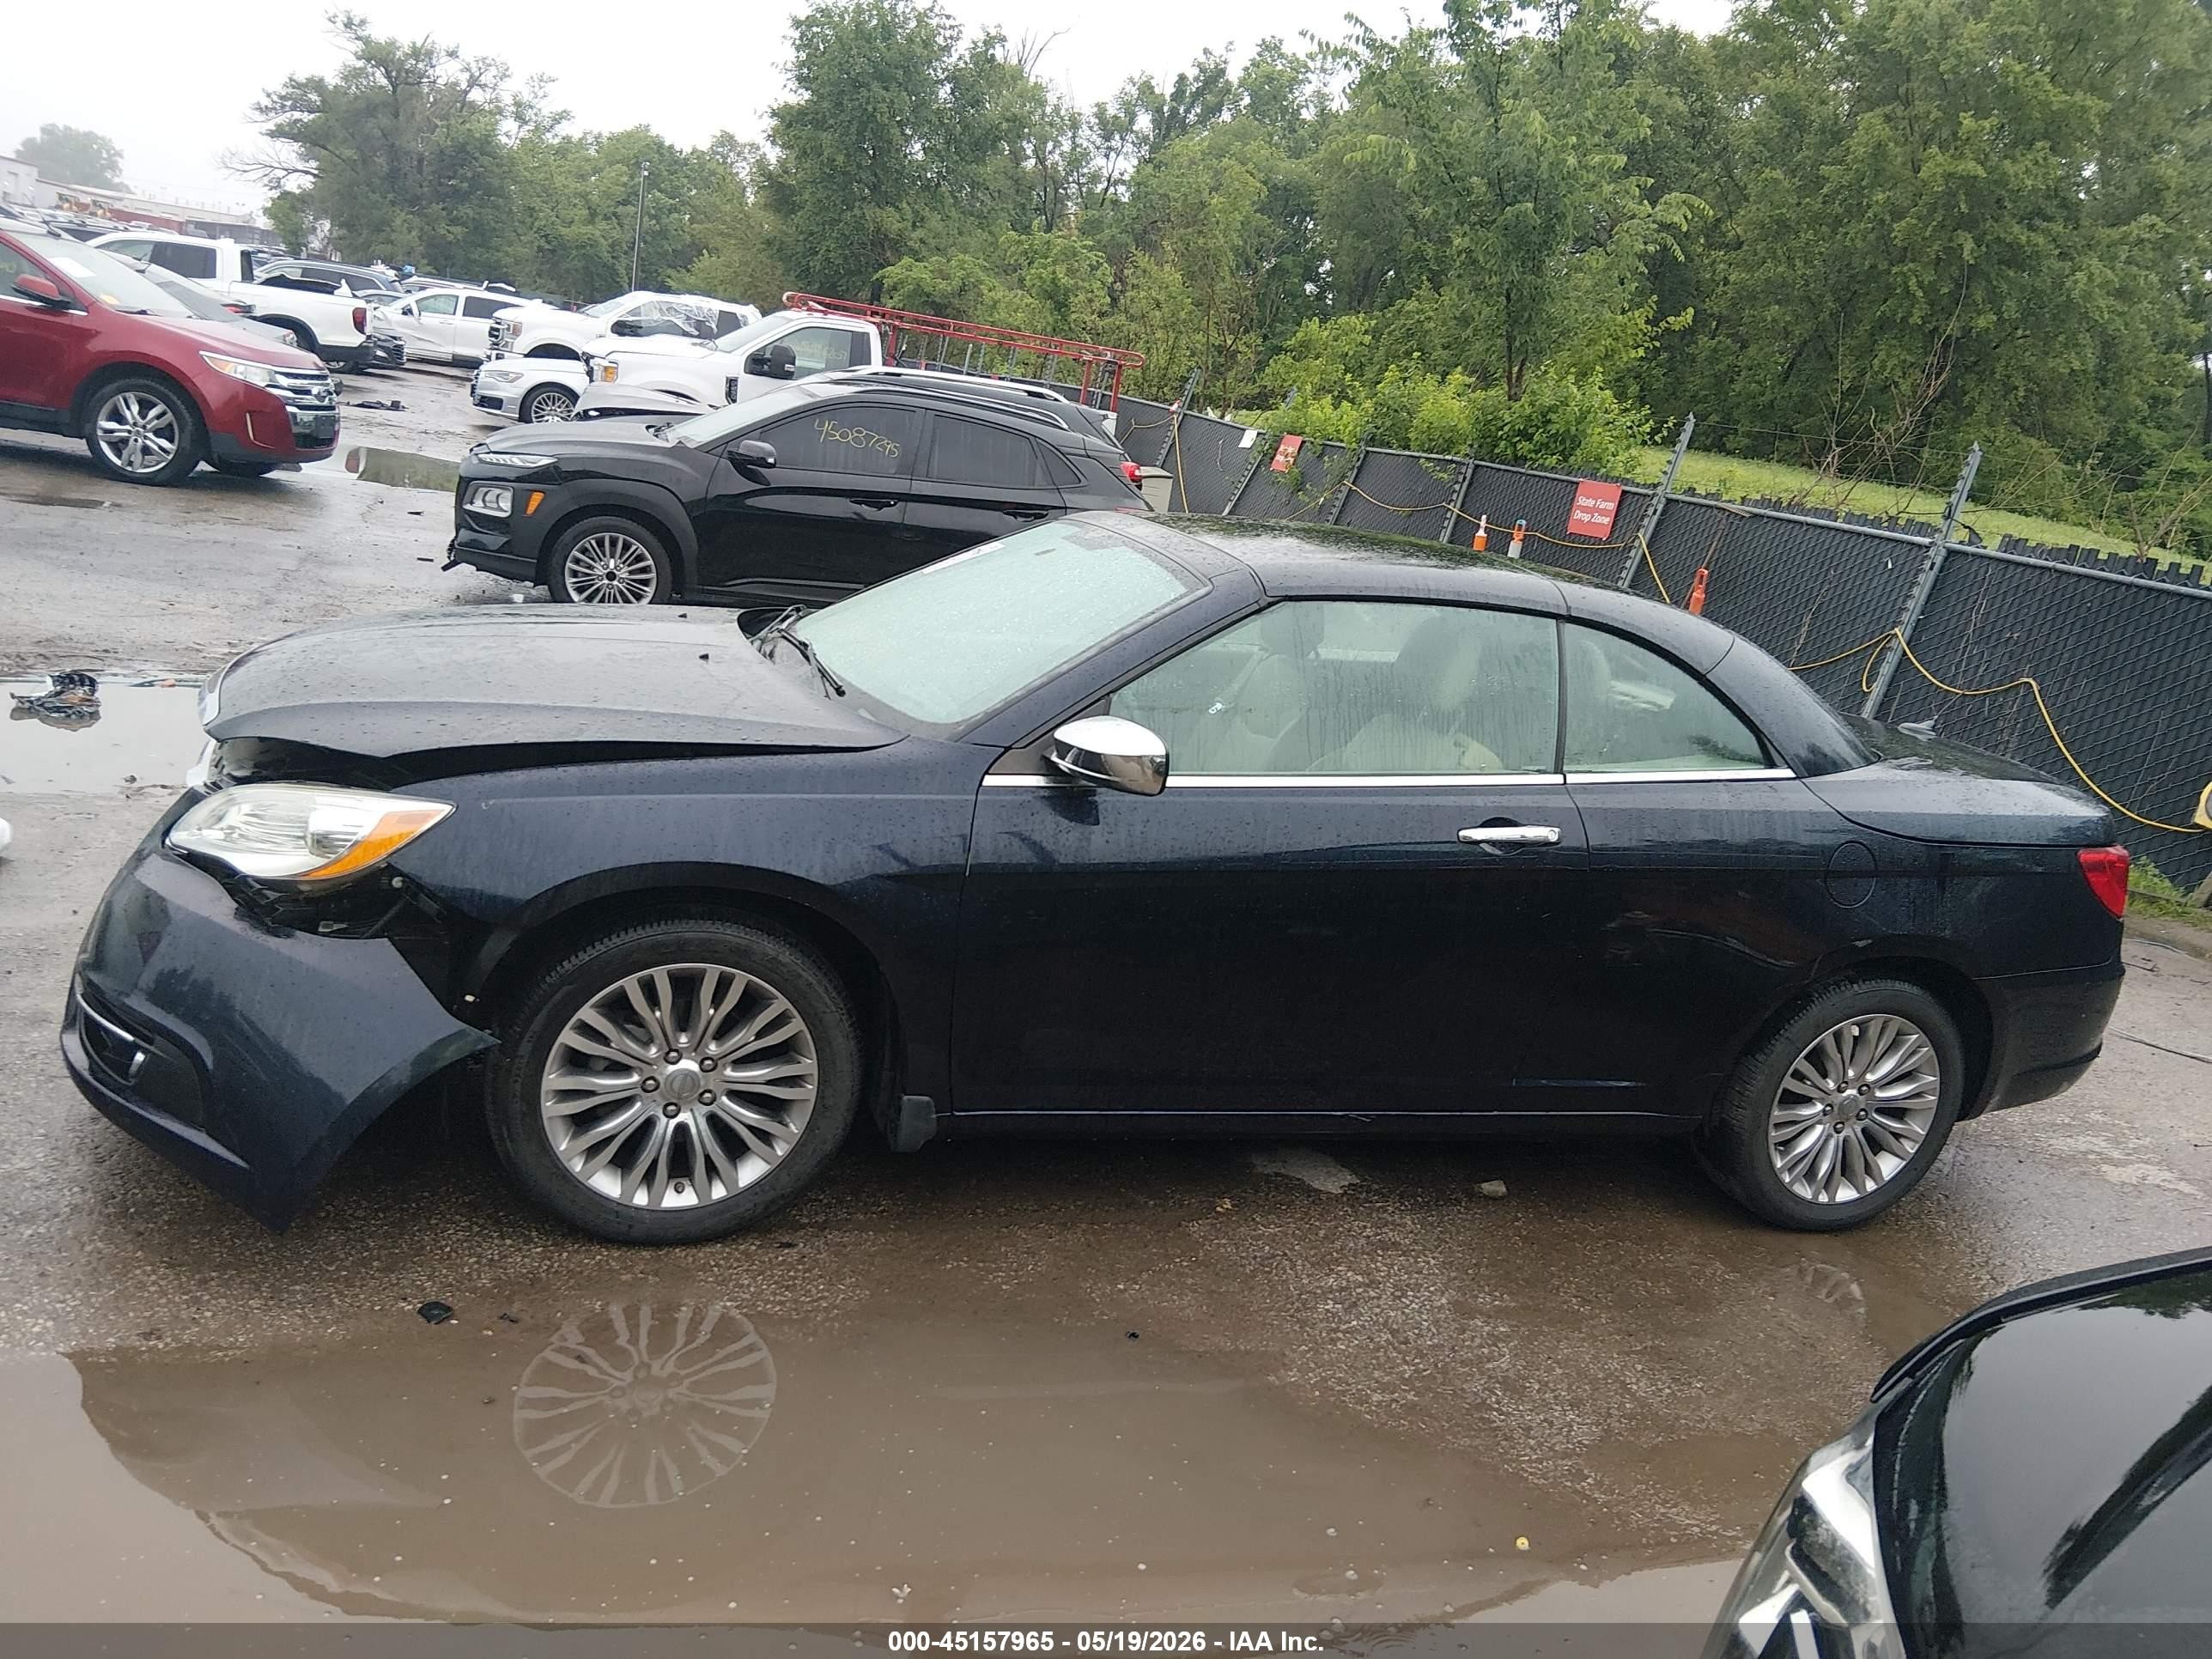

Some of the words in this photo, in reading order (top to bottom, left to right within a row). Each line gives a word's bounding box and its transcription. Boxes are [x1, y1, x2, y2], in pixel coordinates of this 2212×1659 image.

[814, 418, 900, 458] 45087295
[1577, 495, 1595, 507] State
[1595, 499, 1614, 510] Farm
[1573, 510, 1591, 523] Drop
[1591, 513, 1610, 525] Zone
